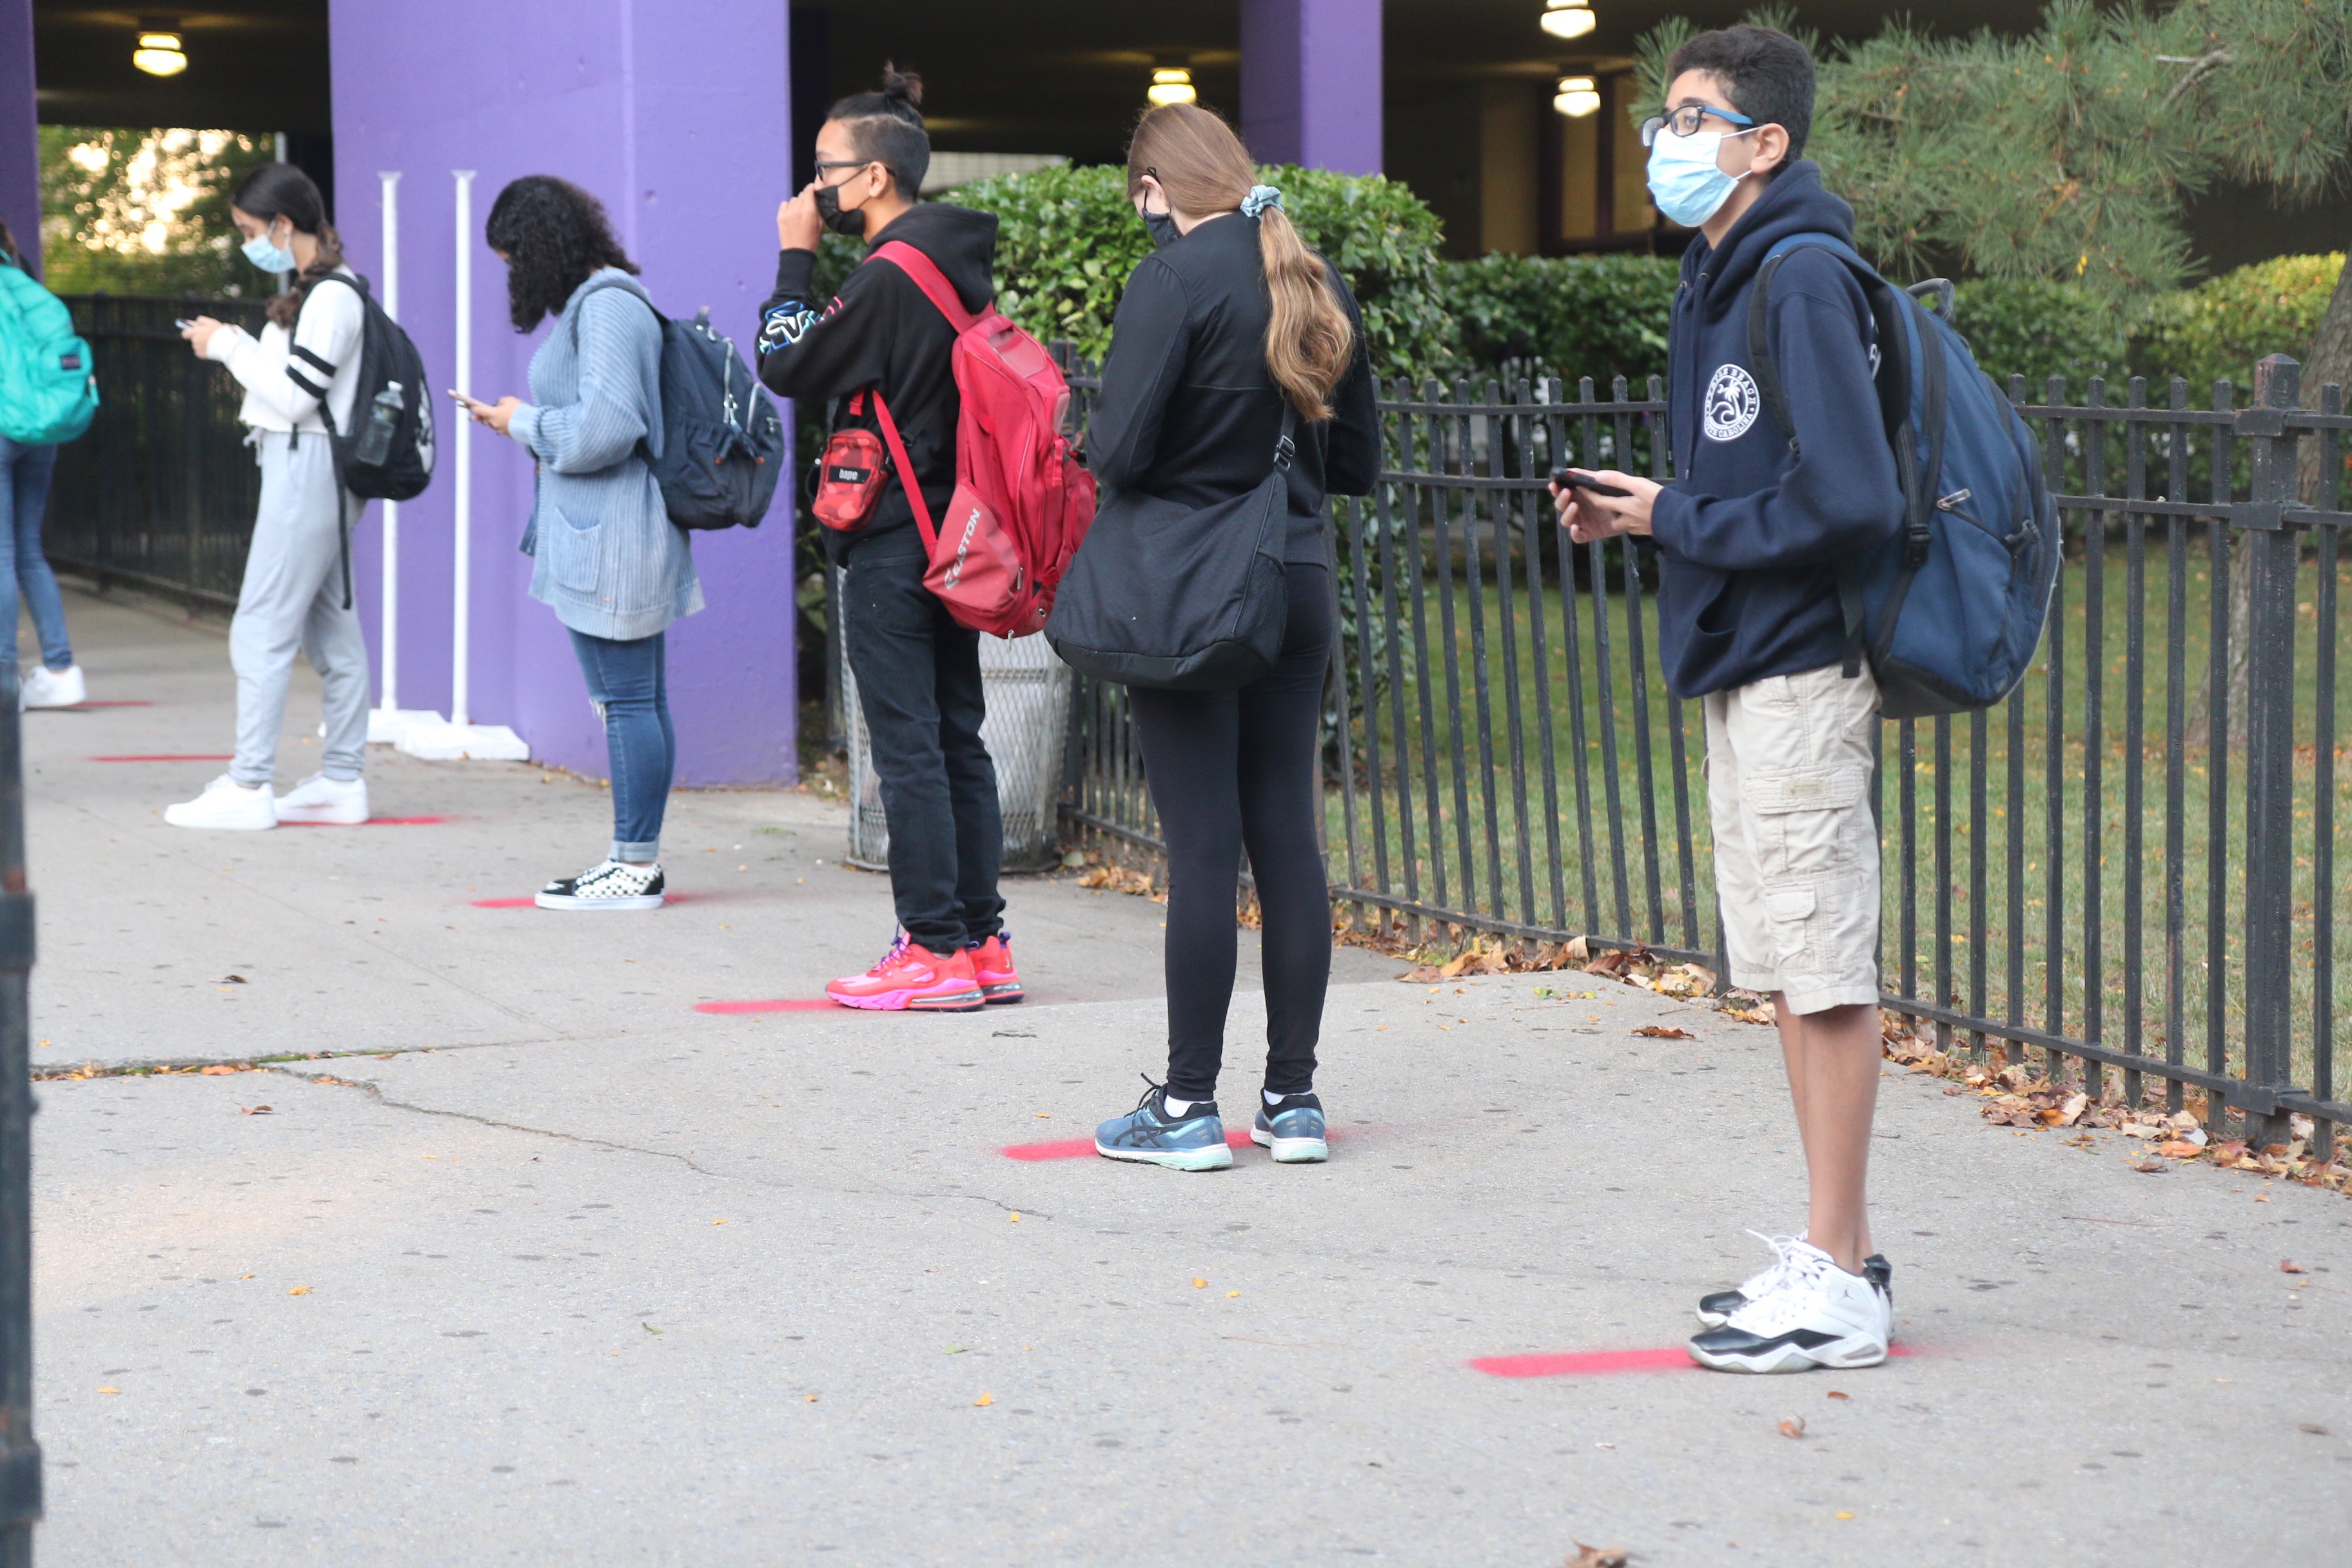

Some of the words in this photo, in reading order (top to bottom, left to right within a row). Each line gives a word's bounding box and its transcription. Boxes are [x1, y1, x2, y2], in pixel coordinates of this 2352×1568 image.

[1730, 368, 1756, 404] BEACH
[1718, 413, 1754, 437] CAROLINA
[839, 468, 858, 480] bape
[952, 507, 981, 578] EASTON
